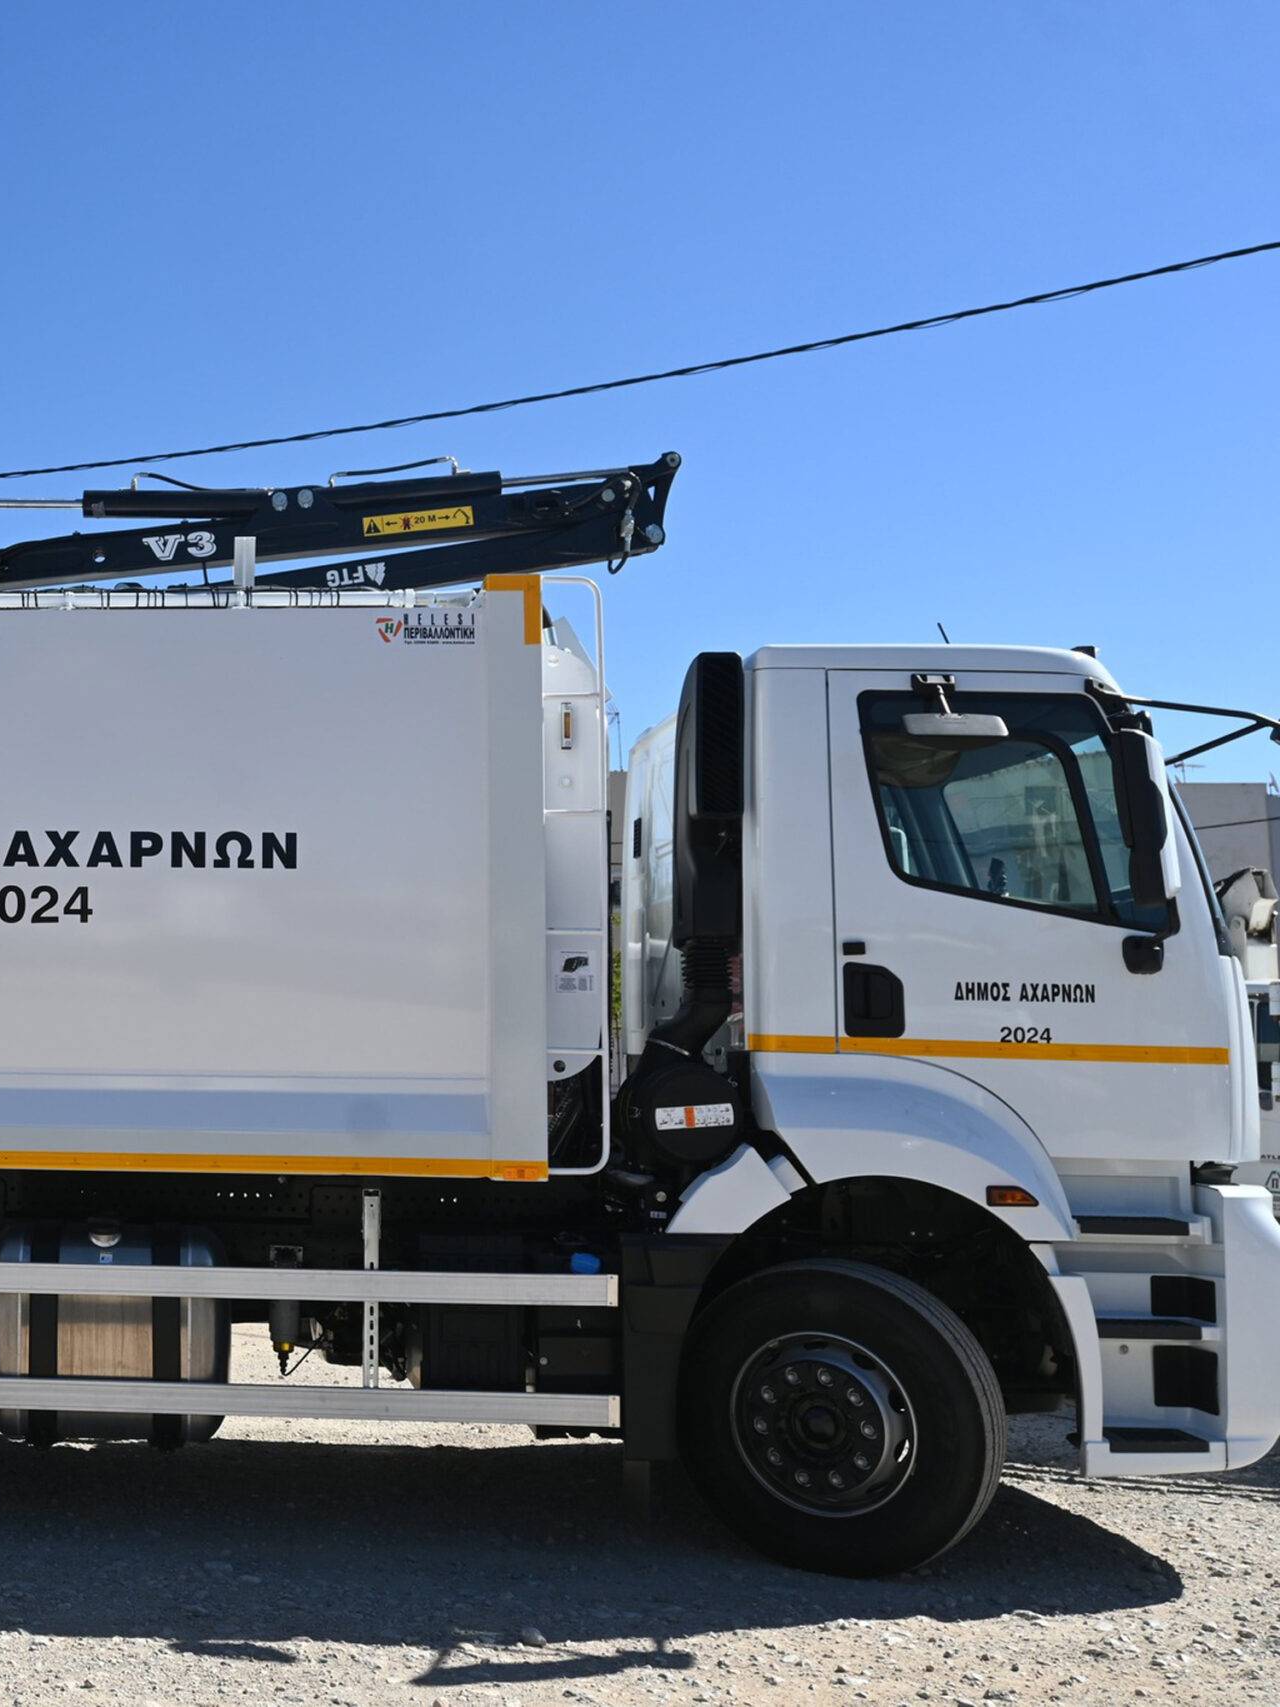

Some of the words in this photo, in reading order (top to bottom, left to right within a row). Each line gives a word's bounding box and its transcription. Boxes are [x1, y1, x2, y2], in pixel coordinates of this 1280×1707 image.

[413, 515, 426, 525] 20
[427, 513, 438, 523] M
[142, 531, 217, 561] V3
[326, 564, 365, 588] FTG
[403, 613, 475, 626] HELESI
[403, 627, 475, 639] ΠΕΡΙΒΑΛΛΟΝΤΙΚΗ
[2, 830, 298, 870] ΑΧΑΡΝΩΝ
[954, 981, 1012, 1002] ΔΗΜΟΣ
[1019, 982, 1096, 1004] ΑΧΑΡΝΩΝ
[1000, 1026, 1053, 1043] 2024
